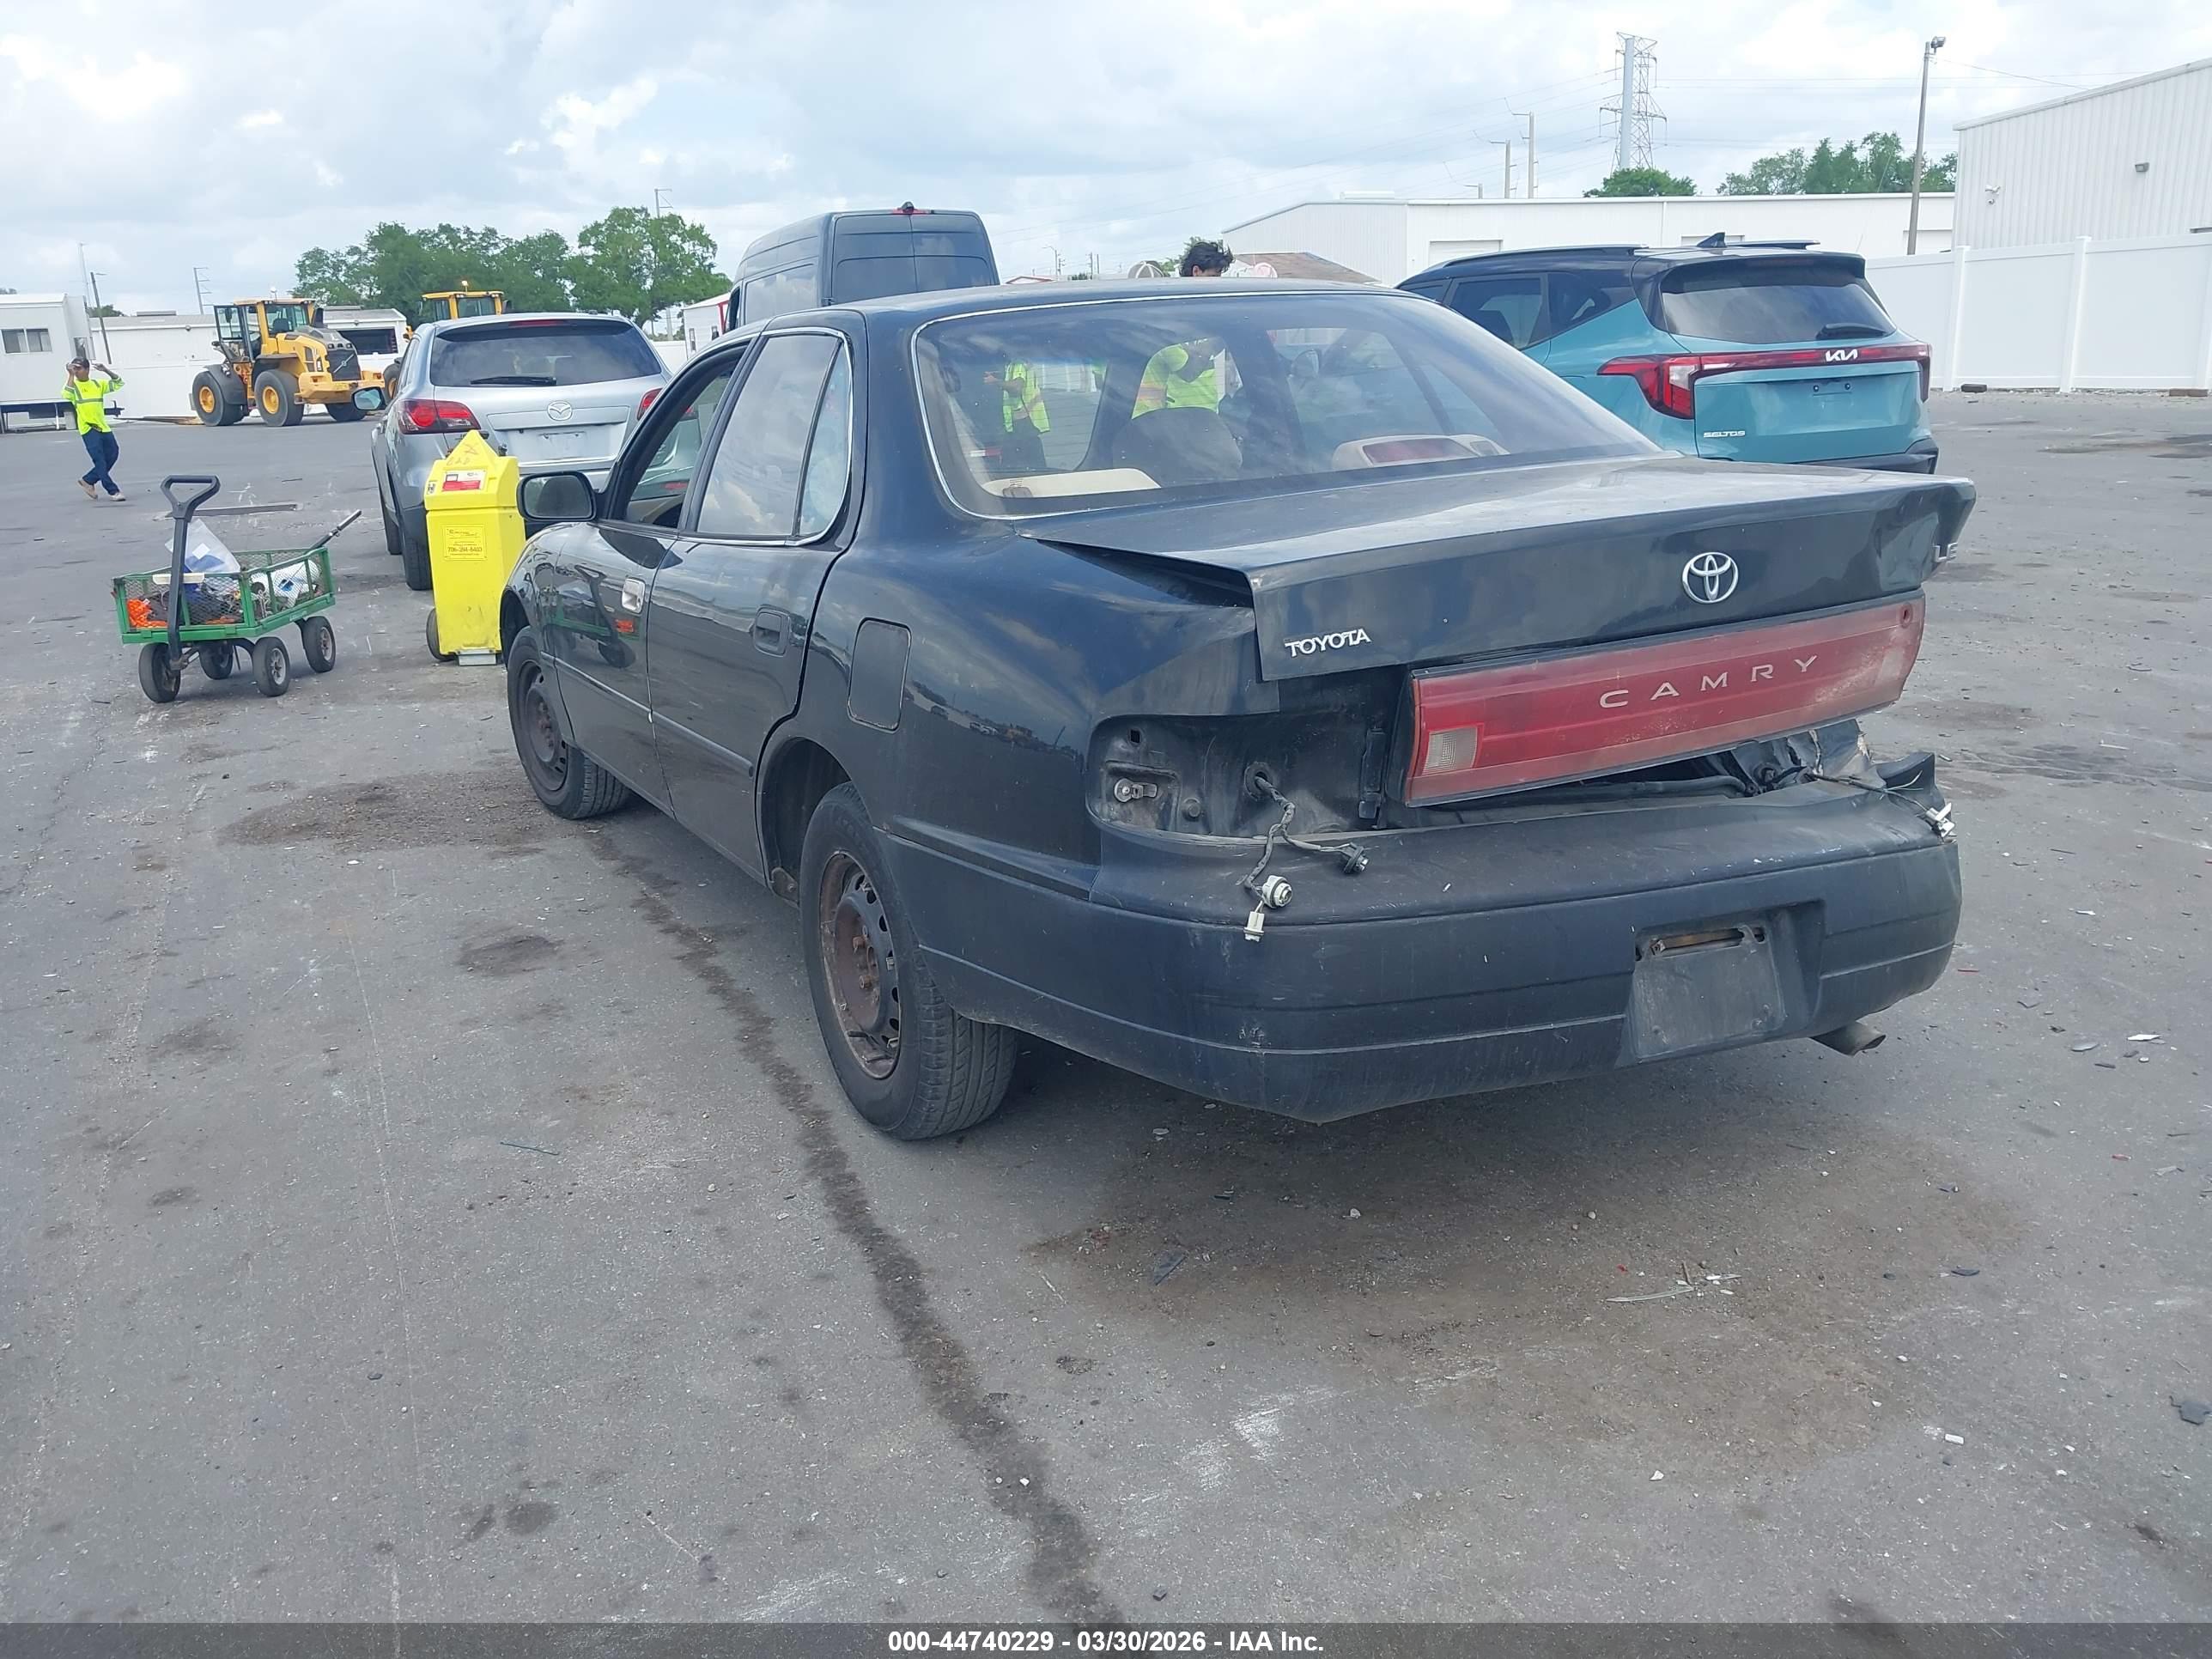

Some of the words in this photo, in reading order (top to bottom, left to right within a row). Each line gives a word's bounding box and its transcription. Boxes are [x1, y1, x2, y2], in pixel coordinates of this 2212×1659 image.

[1826, 349, 1858, 362] KIA
[1933, 542, 1959, 563] LE
[1284, 628, 1372, 658] TOYOTA
[1599, 654, 1818, 708] CAMRY
